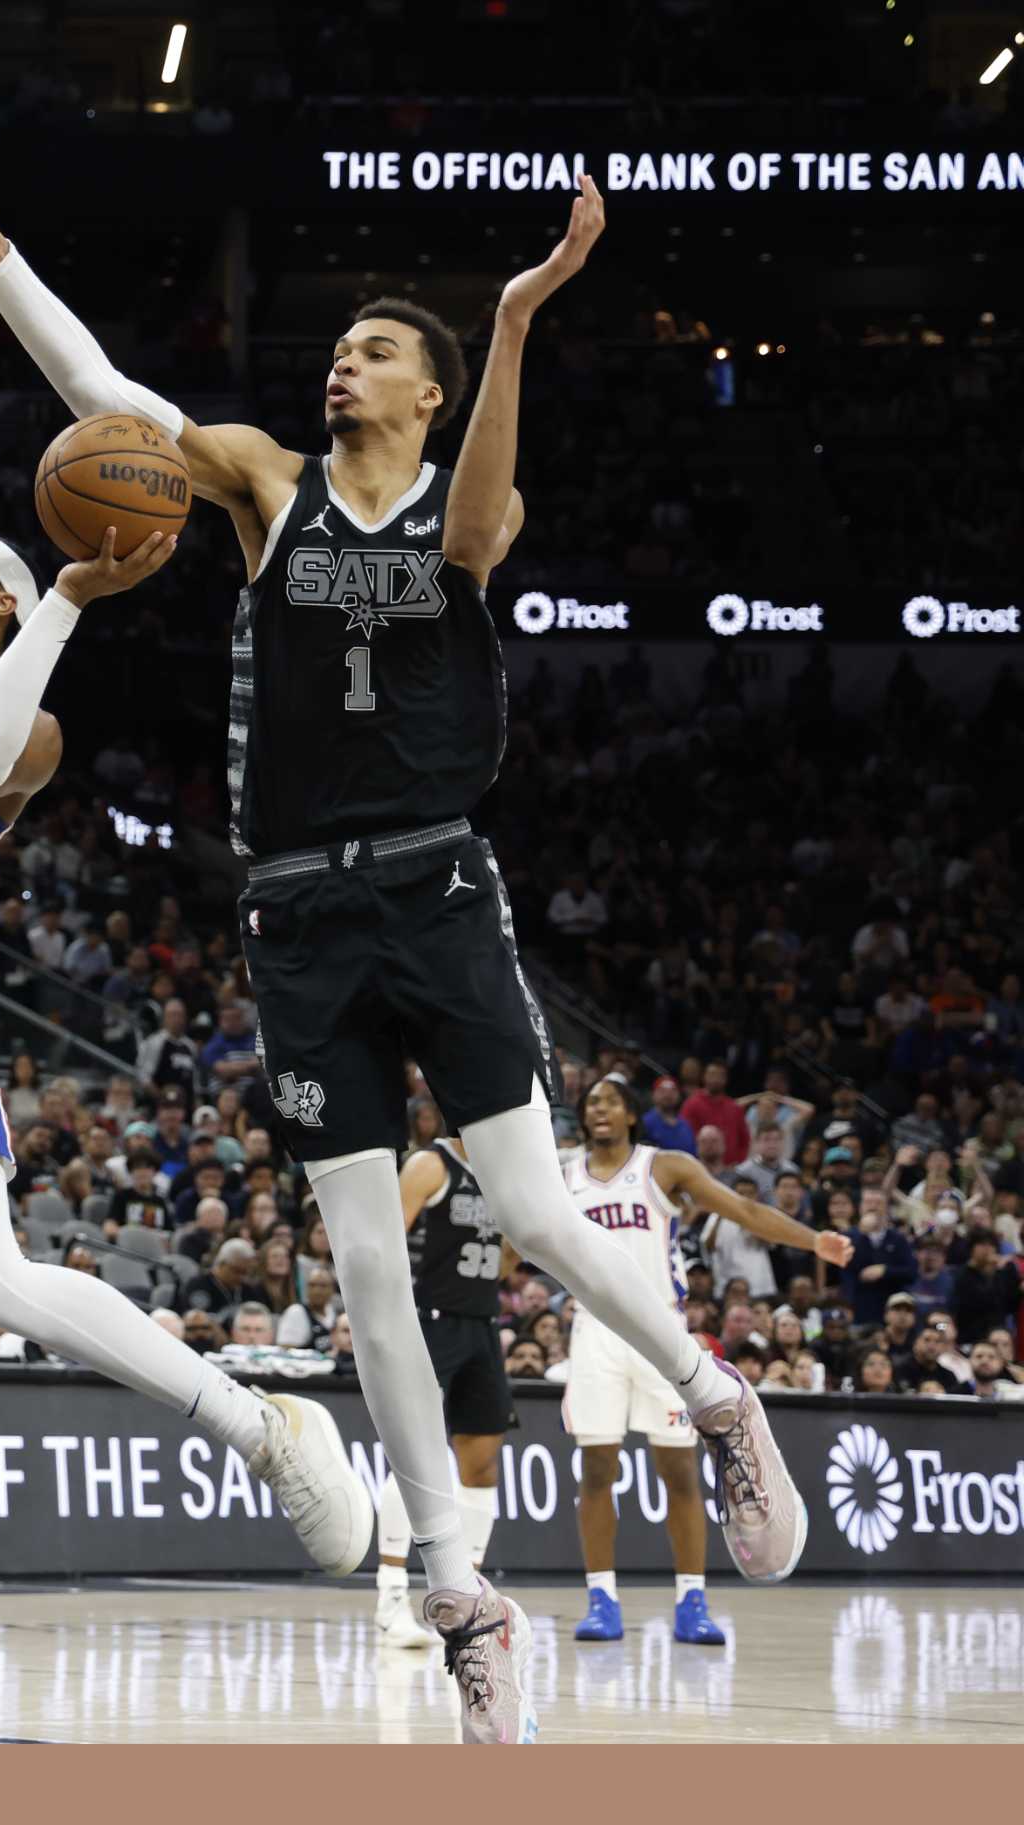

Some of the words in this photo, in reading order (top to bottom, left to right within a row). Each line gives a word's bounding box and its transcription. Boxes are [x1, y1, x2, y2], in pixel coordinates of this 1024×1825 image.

[323, 152, 400, 190] THE
[412, 152, 586, 190] OFFICIAL
[608, 153, 715, 190] BANK
[727, 152, 781, 191] OF
[791, 153, 872, 190] THE
[883, 152, 965, 191] SAN
[99, 462, 187, 508] Wilson
[286, 547, 448, 618] SATX
[557, 598, 630, 629] Frost
[750, 600, 824, 632] Frost
[947, 602, 1021, 633] Frost
[344, 646, 376, 711] 1
[585, 1202, 651, 1231] HILA
[456, 1242, 502, 1281] 33
[42, 1434, 164, 1518] THE
[179, 1436, 289, 1520] SA
